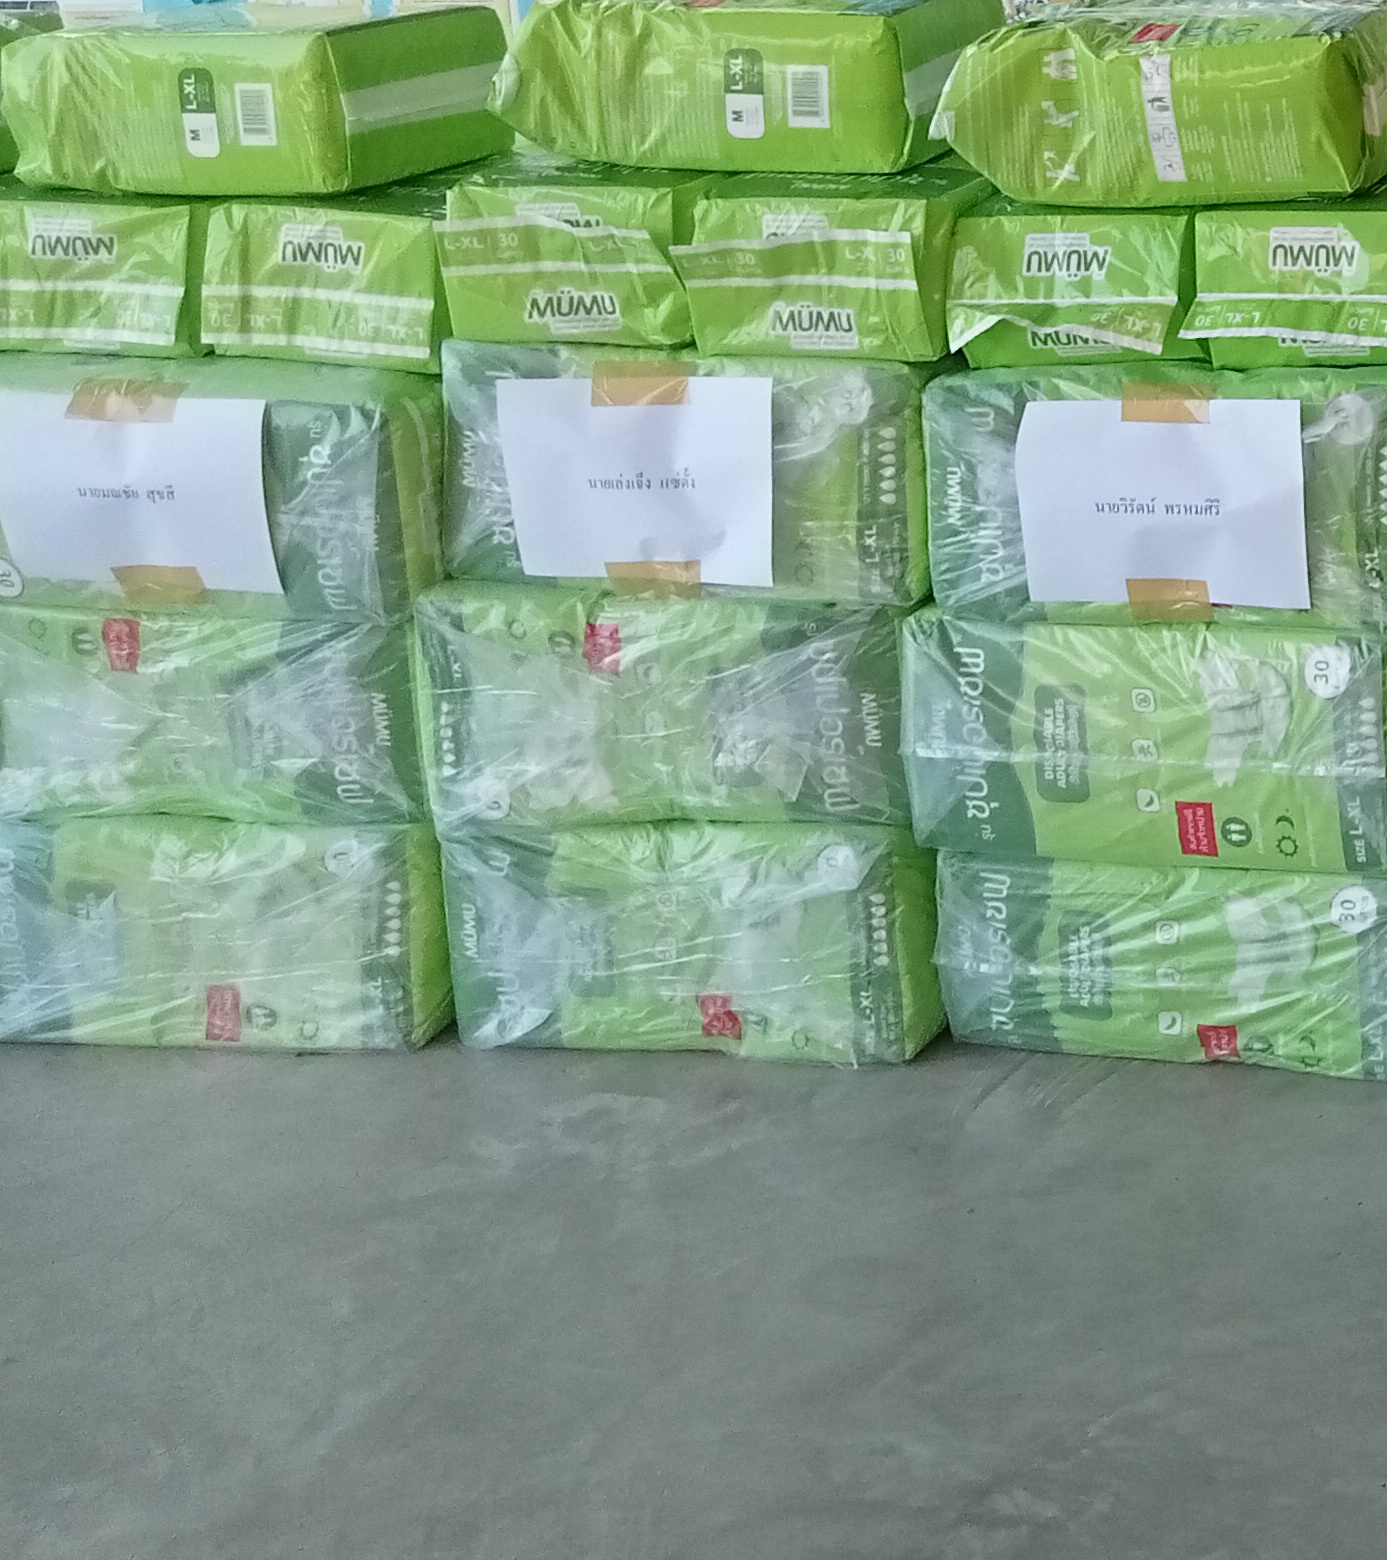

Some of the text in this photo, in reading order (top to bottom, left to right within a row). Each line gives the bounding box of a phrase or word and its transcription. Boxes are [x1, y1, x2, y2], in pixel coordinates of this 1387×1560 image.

[729, 55, 743, 90] L-XL
[183, 74, 197, 109] L-XL
[732, 110, 744, 122] M
[189, 129, 201, 141] M
[31, 235, 115, 260] MÜMU
[282, 241, 362, 270] MÜMU
[1271, 243, 1356, 273] MÜMU
[1026, 249, 1109, 278] MÜMU
[527, 290, 618, 320] MÜMU
[771, 305, 853, 333] MÜMU
[1195, 311, 1261, 327] L-XL 30
[1348, 317, 1367, 330] 30
[460, 430, 477, 487] MÜMU
[947, 467, 963, 524] MÜMU
[865, 525, 879, 563] L-XL
[1313, 659, 1329, 685] 30
[370, 692, 391, 746] MÜMU
[860, 692, 883, 747] MÜMU
[1055, 698, 1066, 747] DIAPERS
[1349, 795, 1363, 836] L-XL
[1339, 899, 1356, 923] 30
